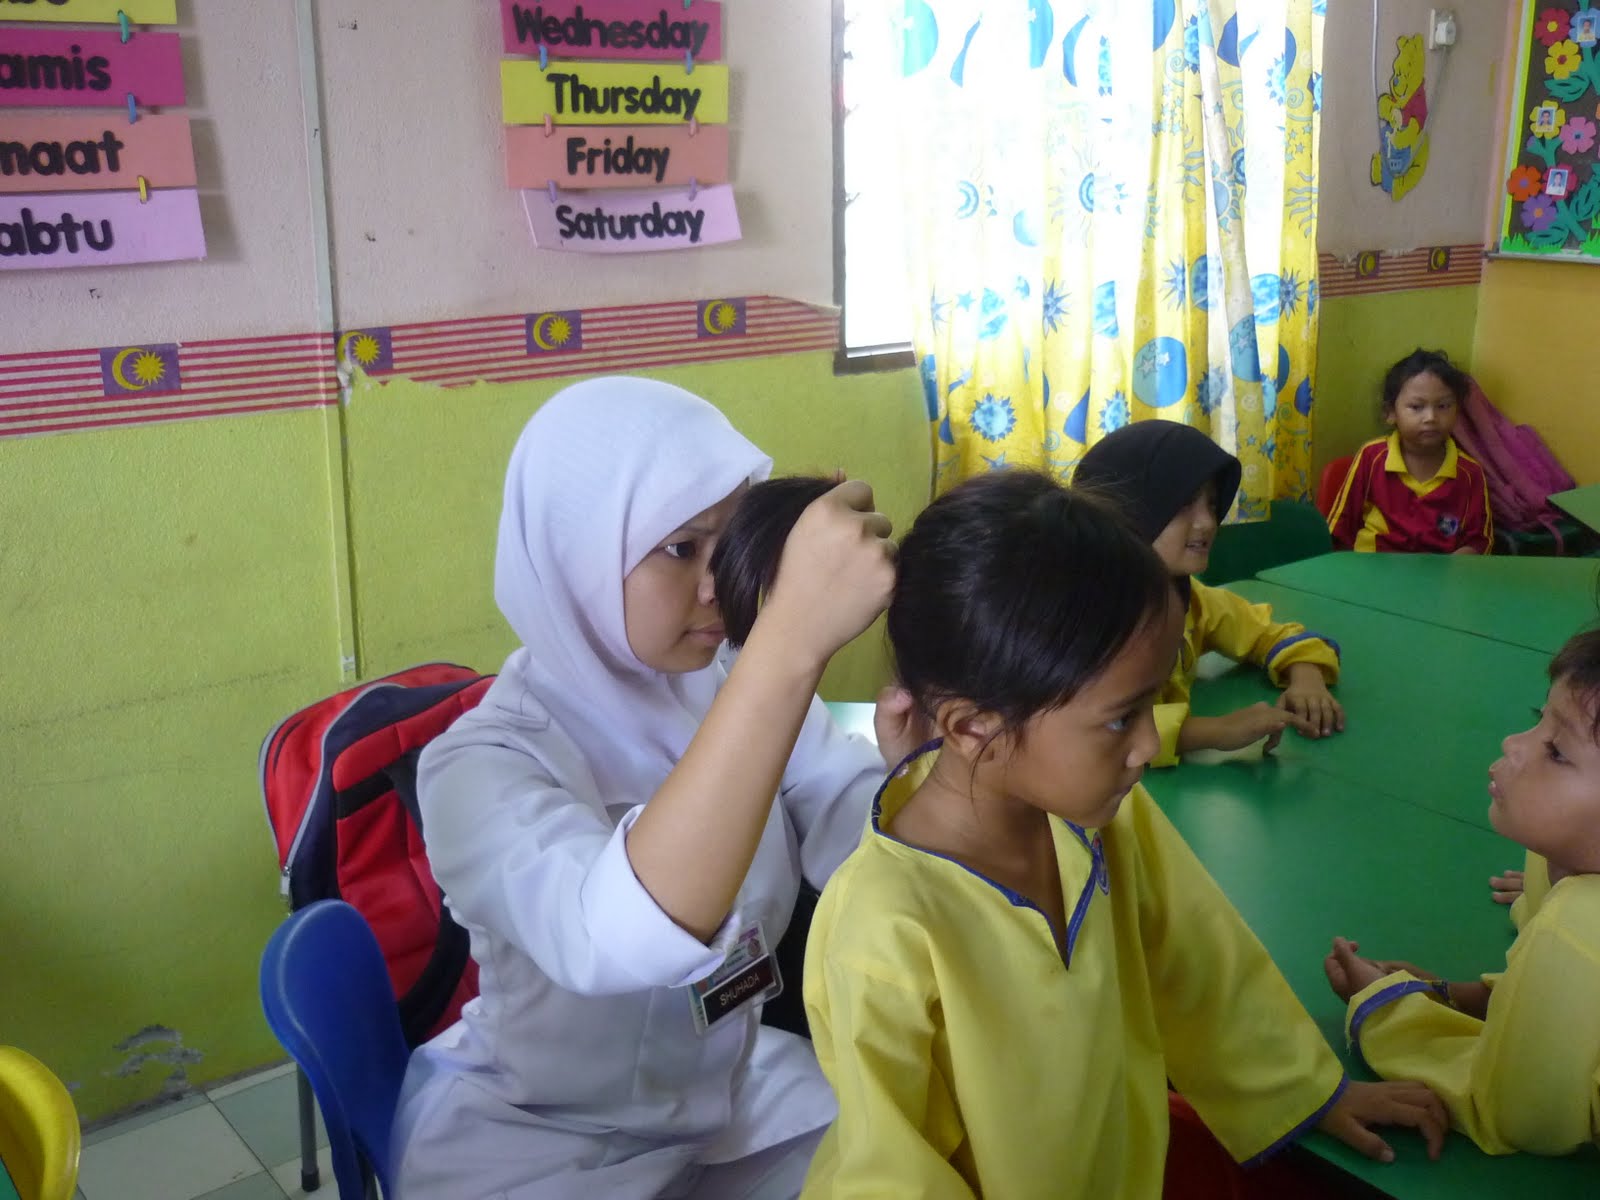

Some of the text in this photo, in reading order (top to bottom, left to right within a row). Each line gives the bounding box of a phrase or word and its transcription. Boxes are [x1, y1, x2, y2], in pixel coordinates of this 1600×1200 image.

[512, 4, 709, 57] Wednesday
[546, 73, 701, 121] Thursday
[566, 136, 670, 183] Friday
[555, 201, 705, 243] Saturday
[719, 973, 760, 1006] SHUHADA
